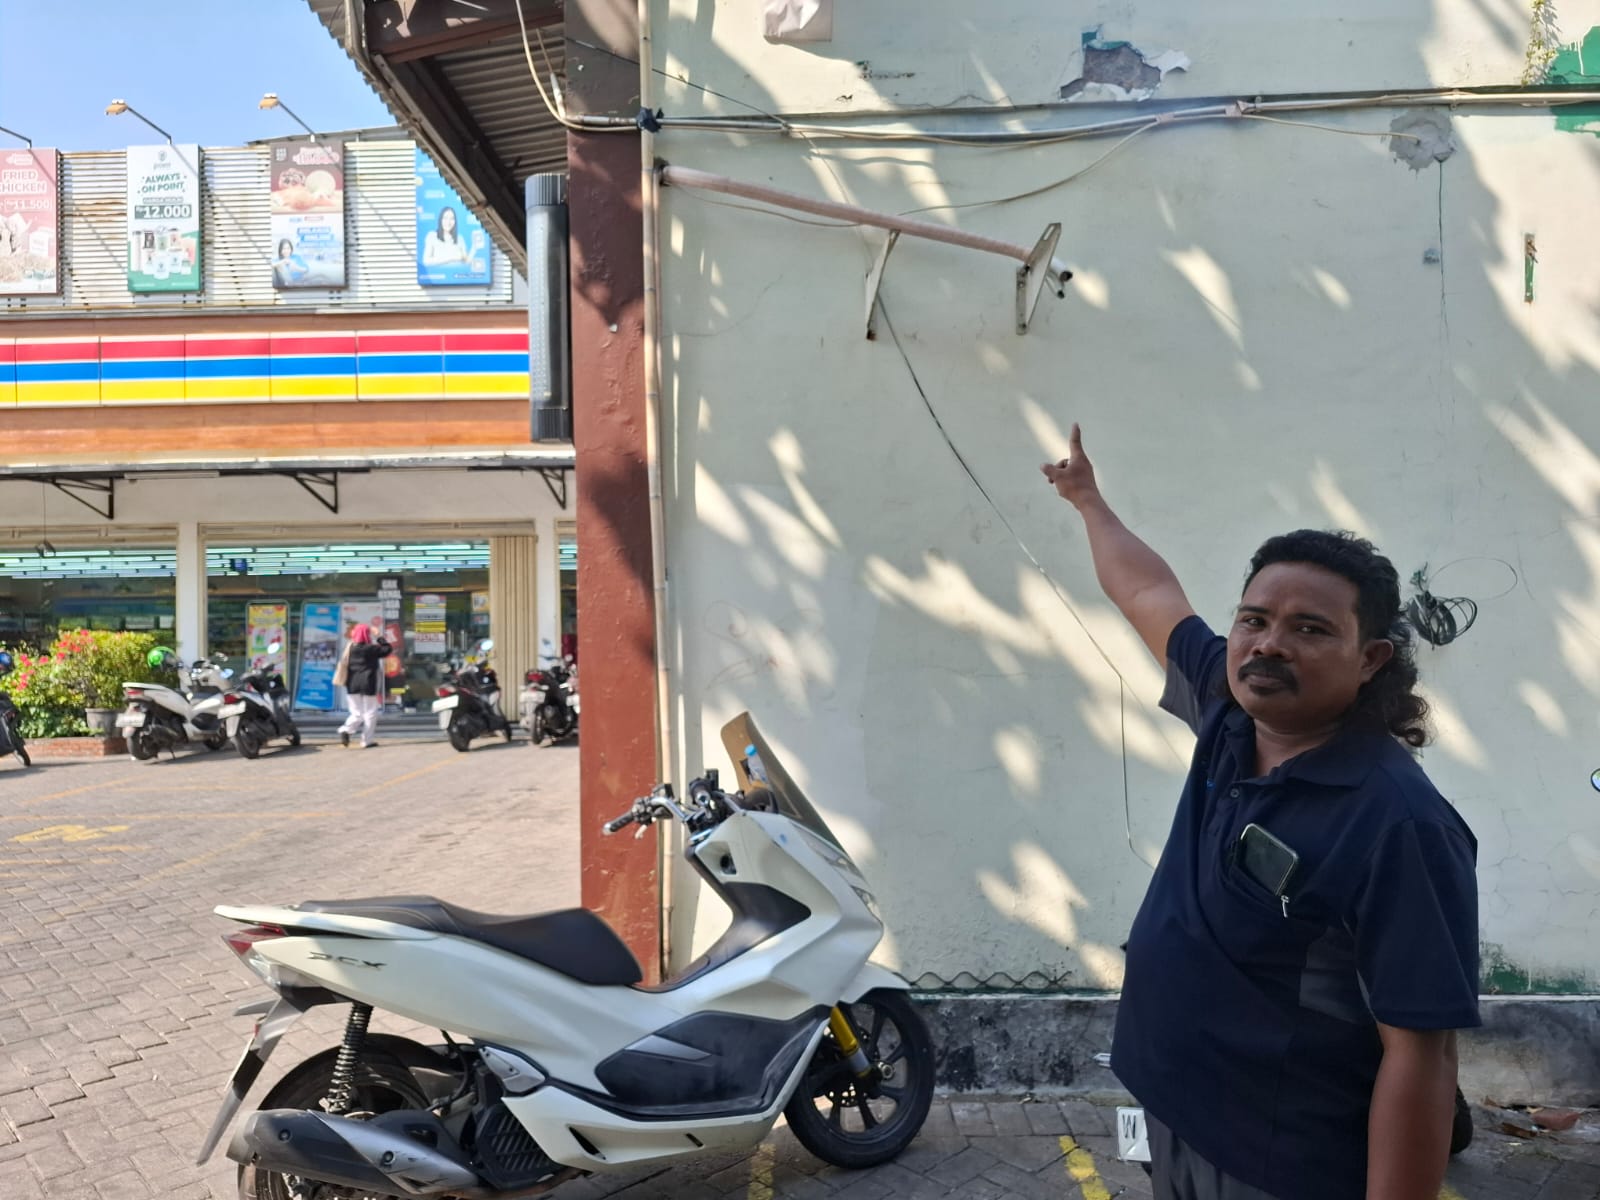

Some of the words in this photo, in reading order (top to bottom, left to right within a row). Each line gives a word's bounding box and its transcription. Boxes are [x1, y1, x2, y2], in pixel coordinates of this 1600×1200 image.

[3, 171, 37, 180] FRIED
[145, 173, 180, 183] ALWAYS
[141, 185, 155, 193] ON
[157, 181, 184, 192] POINT
[1122, 1113, 1136, 1139] W
